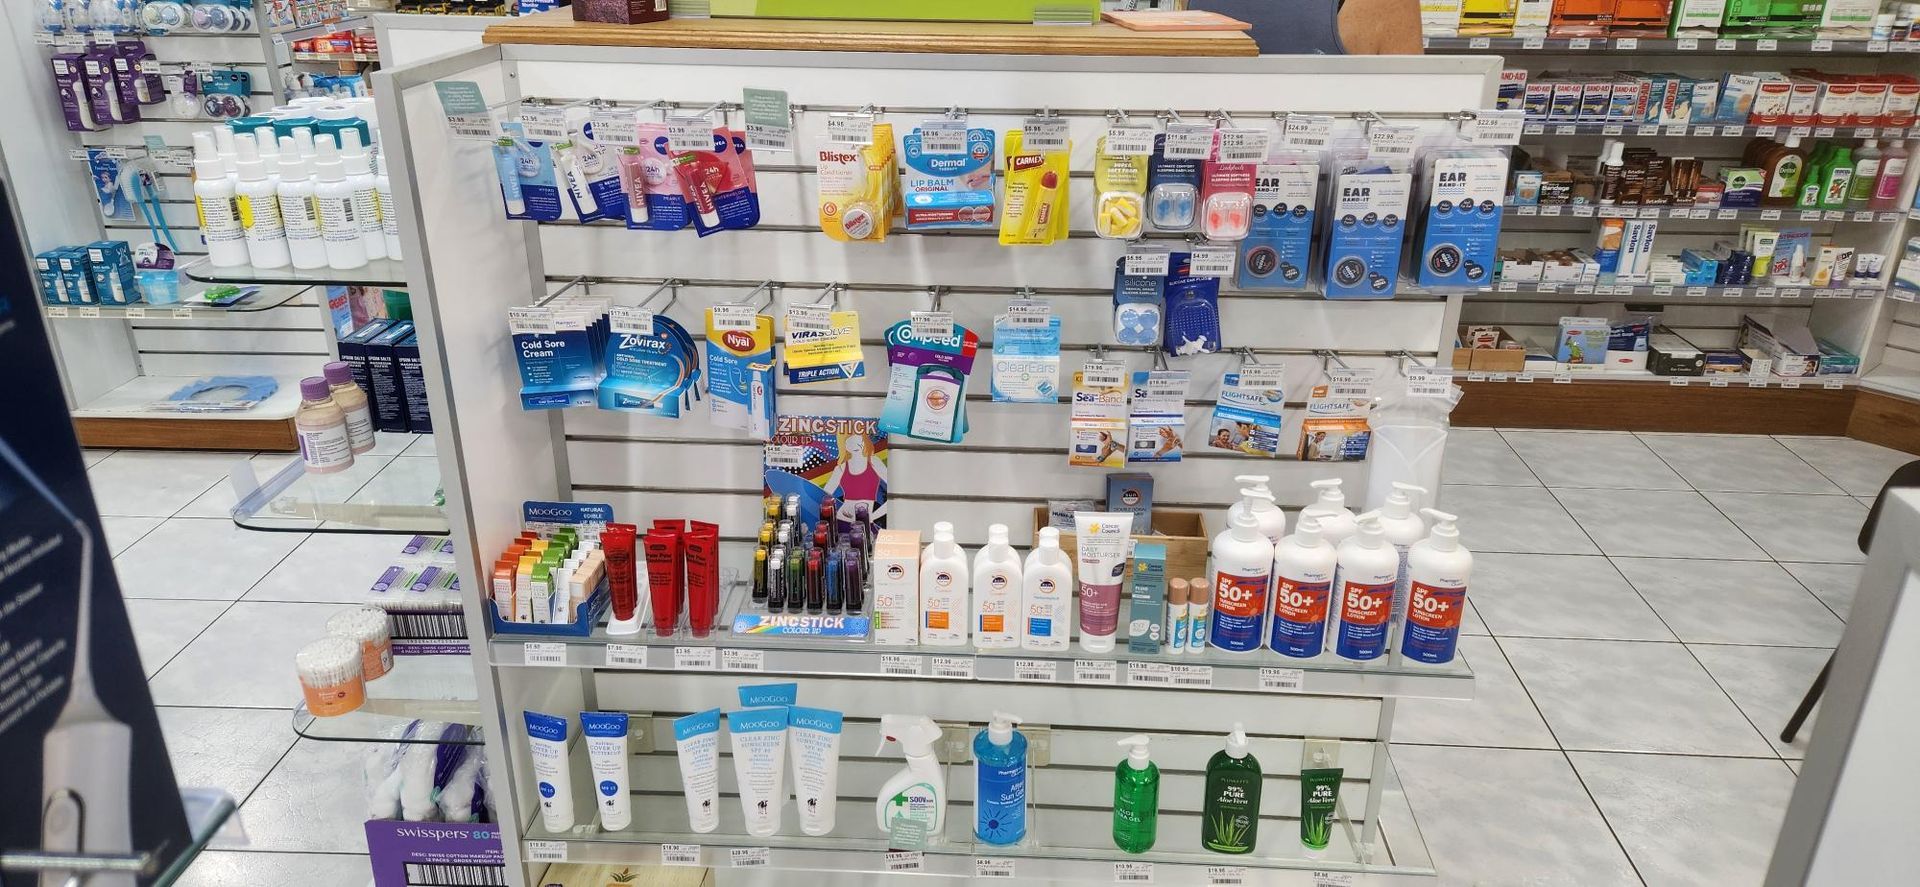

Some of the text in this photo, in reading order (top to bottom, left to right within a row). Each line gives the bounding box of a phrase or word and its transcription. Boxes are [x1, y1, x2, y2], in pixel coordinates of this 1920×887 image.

[1527, 85, 1550, 93] BAND-AID
[1557, 85, 1581, 93] BAND-AID
[1586, 84, 1610, 92] BAND-AID
[1614, 85, 1638, 93] BAND-AID
[1637, 83, 1650, 115] BAND-AID
[519, 157, 534, 165] 24h
[582, 154, 596, 162] 24h
[819, 151, 856, 165] Blistex
[931, 158, 965, 167] Dermal
[1016, 156, 1043, 166] CARMEX
[645, 166, 660, 174] 24h
[704, 166, 719, 175] 24h
[1440, 172, 1467, 182] EAR
[567, 171, 583, 199] NIVEA
[1255, 178, 1279, 187] EAR
[635, 177, 645, 206] NIVEA
[700, 182, 714, 210] NIVEA
[1343, 187, 1370, 196] EAR
[845, 213, 865, 230] Blistex
[1628, 224, 1641, 253] Savlon
[1643, 223, 1656, 253] Savlon
[1124, 279, 1157, 287] silicone
[791, 327, 852, 340] VIRASOLVE
[521, 340, 565, 350] Cold Sore
[619, 334, 667, 350] Zovirax
[728, 334, 750, 346] Nyal
[523, 350, 554, 358] Cream
[641, 359, 667, 367] TREATMENT
[709, 354, 738, 365] Cold Sore
[798, 367, 840, 378] TRIPLE ACTION
[997, 361, 1056, 374] ClearEars
[1076, 391, 1124, 403] Sea-Band
[1221, 390, 1263, 403] FLIGHTSAFE
[1310, 401, 1351, 411] FLIGHTSAFE
[777, 418, 877, 434] ZINCSTICK
[529, 508, 572, 516] MooGoo
[1081, 587, 1099, 598] 50+
[1218, 584, 1252, 600] 50+
[1416, 586, 1428, 594] SPF
[1218, 599, 1246, 608] SUNSCREEN
[1279, 591, 1314, 607] 50+
[1346, 592, 1382, 611] 50+
[1413, 594, 1449, 613] 50+
[1218, 603, 1235, 611] LOTION
[1279, 604, 1308, 615] SUNSCREEN
[1278, 608, 1296, 617] LOTION
[1346, 612, 1365, 622] LOTION
[1347, 608, 1376, 617] SUNSCREEN
[1412, 613, 1430, 622] LOTION
[1413, 608, 1443, 620] SUNSCREEN
[759, 615, 844, 628] ZINCSTICK
[749, 695, 788, 704] MooGoo
[682, 721, 714, 735] MooGoo
[739, 721, 780, 730] MooGoo
[796, 717, 833, 730] MooGoo
[529, 724, 559, 735] MooGoo
[1227, 785, 1244, 793] 99%
[1312, 790, 1332, 798] PURE
[1000, 792, 1015, 801] Sun
[1223, 790, 1245, 799] PURE
[1119, 808, 1134, 817] ALOE
[396, 826, 490, 842] swisspers 80
